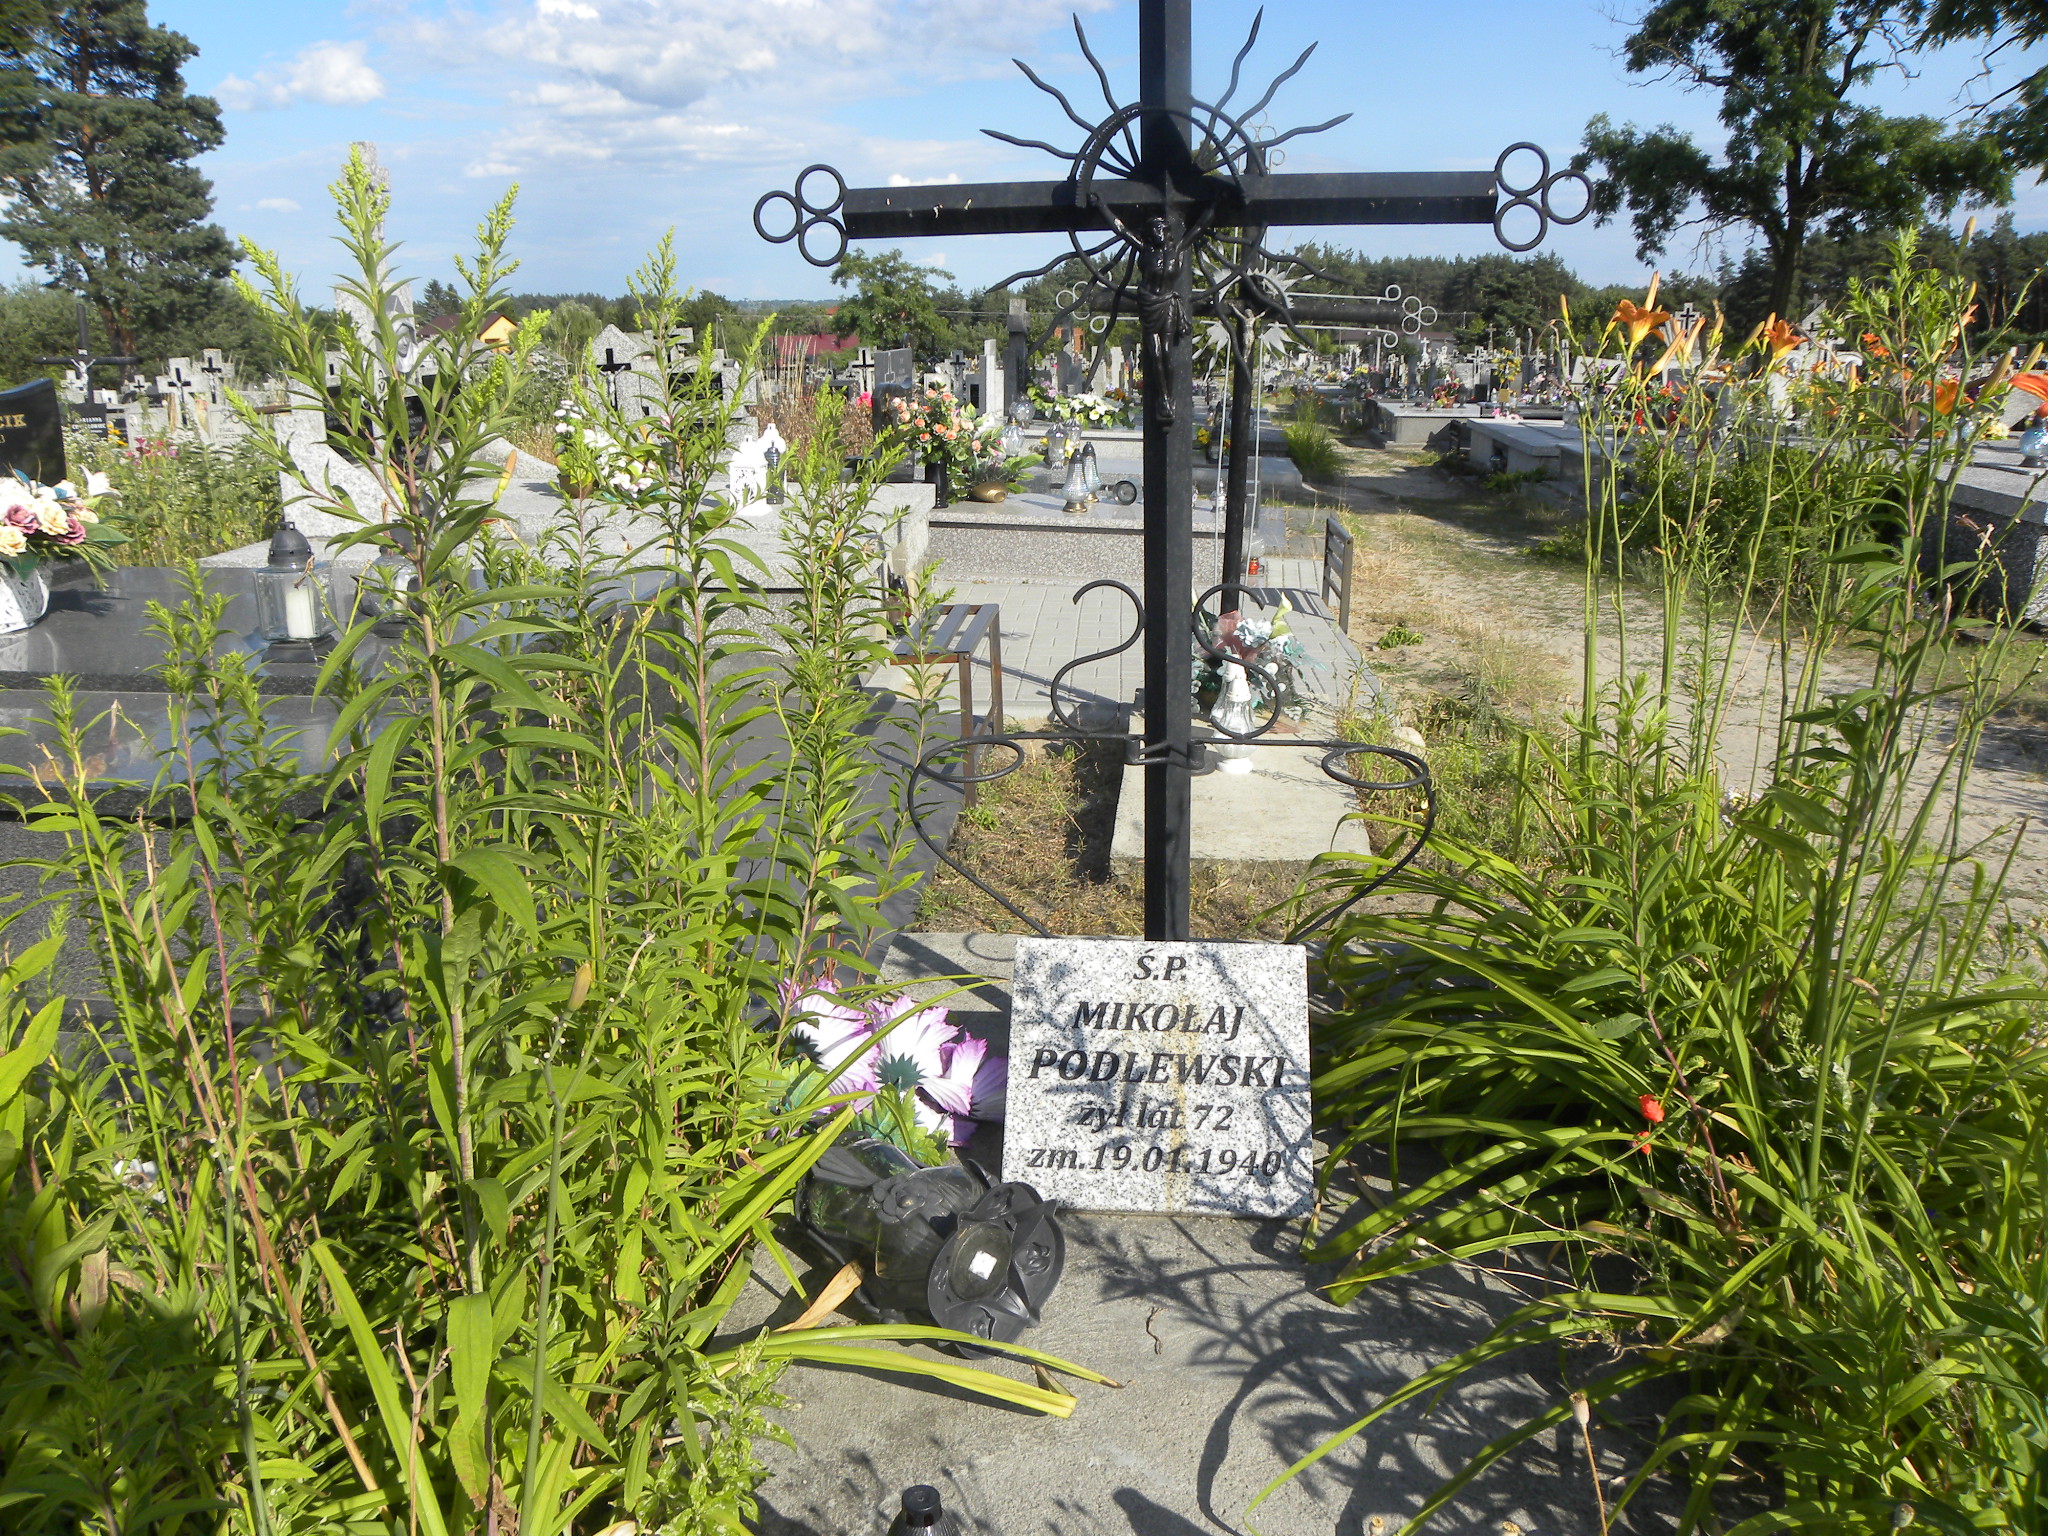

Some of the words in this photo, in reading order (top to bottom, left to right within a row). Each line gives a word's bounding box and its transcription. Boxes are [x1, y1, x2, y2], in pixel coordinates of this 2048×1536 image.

[1133, 949, 1187, 981] Ś.P.
[1073, 1001, 1245, 1041] MIKOŁAJ
[1028, 1048, 1288, 1088] PODLEWSKI
[1077, 1101, 1127, 1133] żył
[1139, 1101, 1186, 1130] lat
[1194, 1104, 1235, 1131] 72
